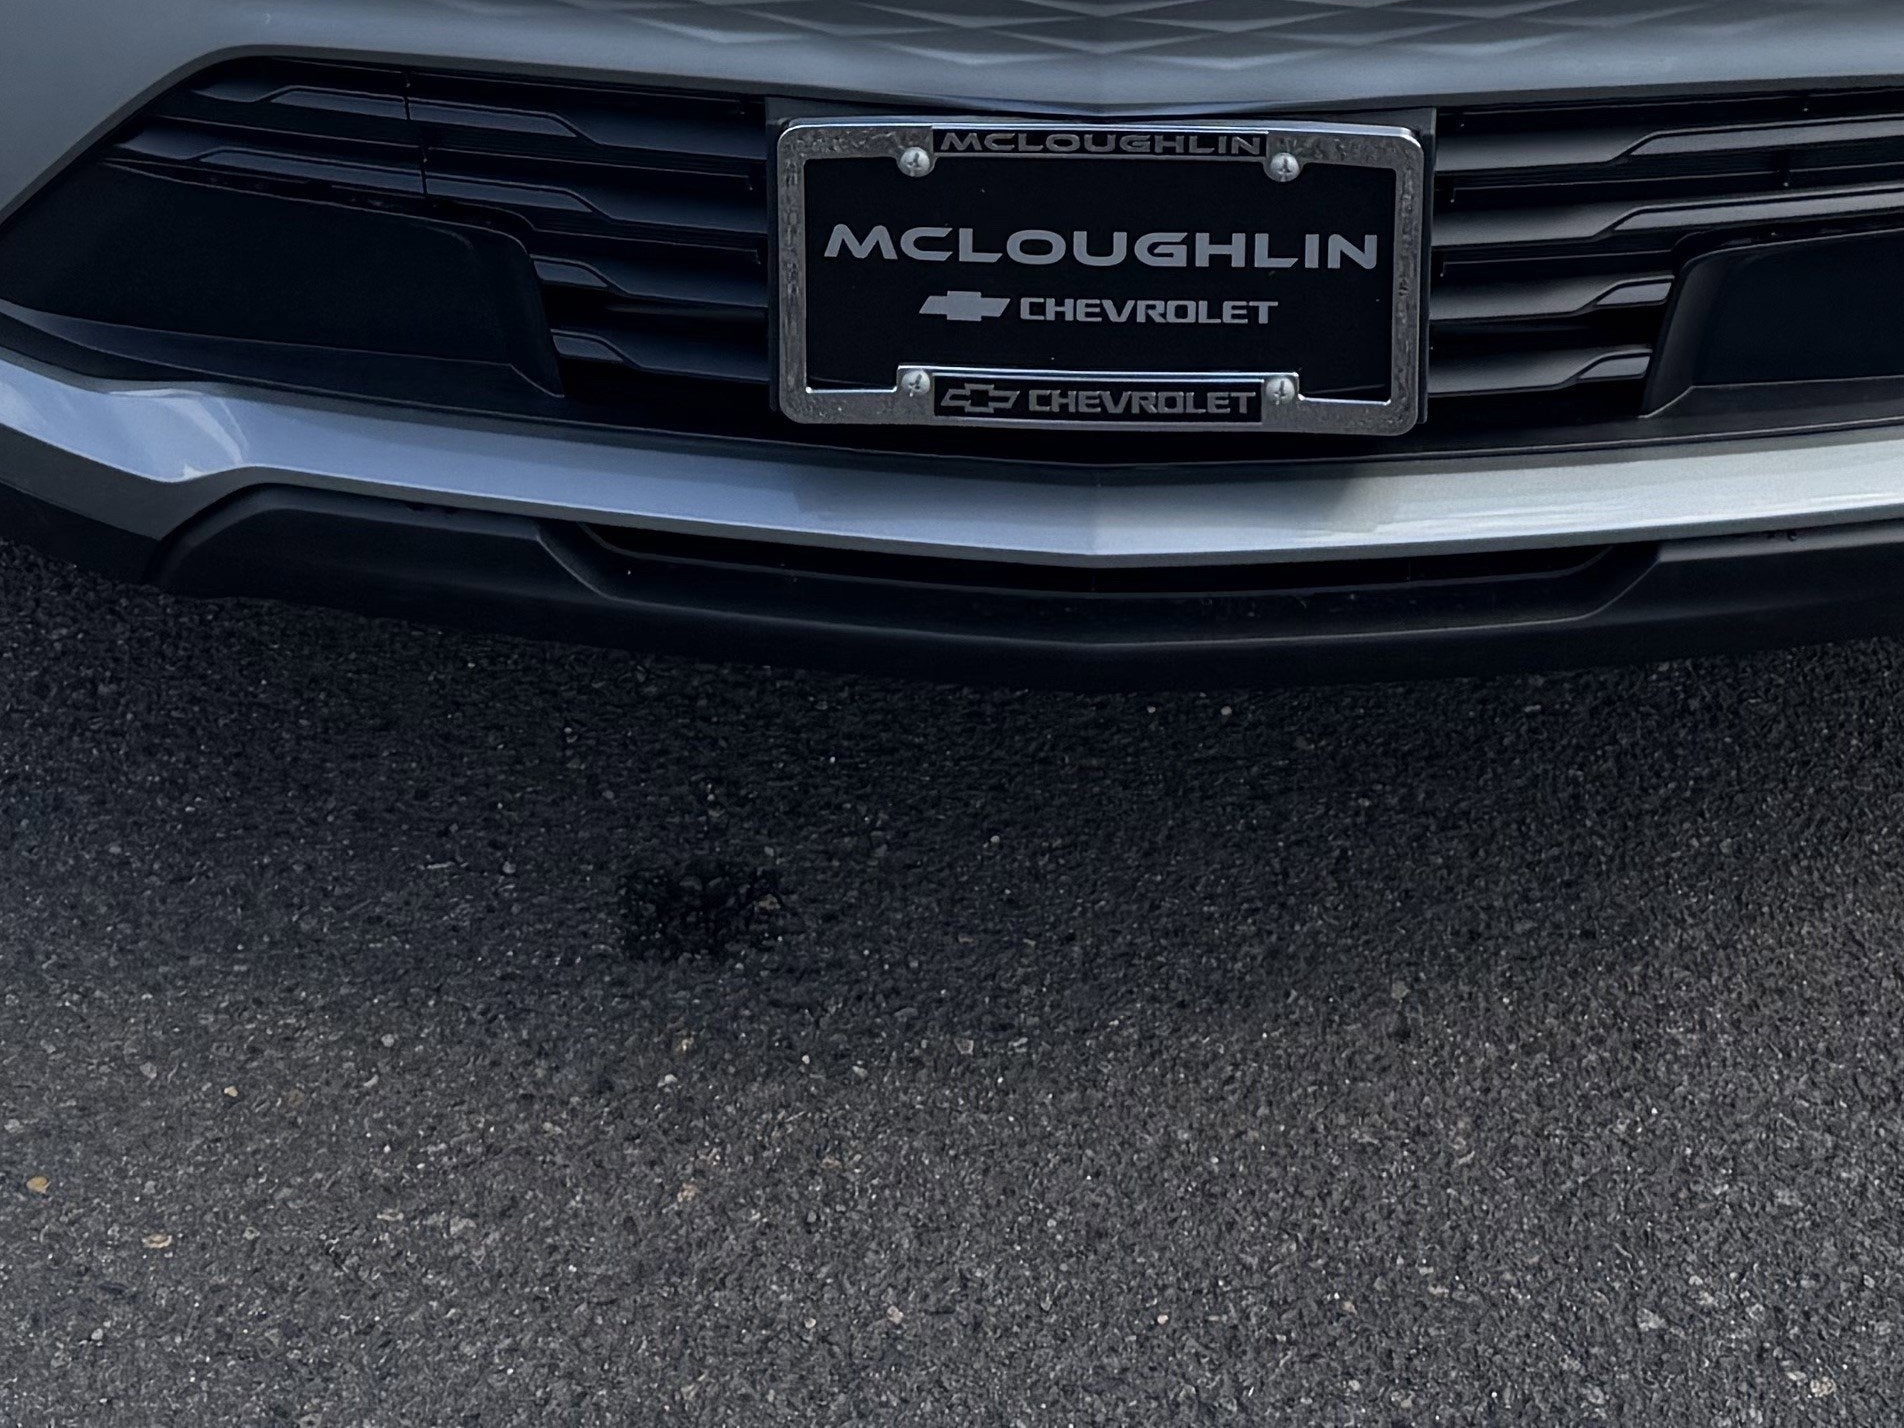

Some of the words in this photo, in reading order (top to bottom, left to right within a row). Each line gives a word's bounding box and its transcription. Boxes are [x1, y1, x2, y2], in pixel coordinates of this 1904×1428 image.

[940, 131, 1262, 156] MCLOUGHLIN
[823, 223, 1378, 270] MCLOUGHLIN
[1019, 296, 1279, 324] CHEVROLET
[1028, 389, 1257, 415] CHEVROLET
